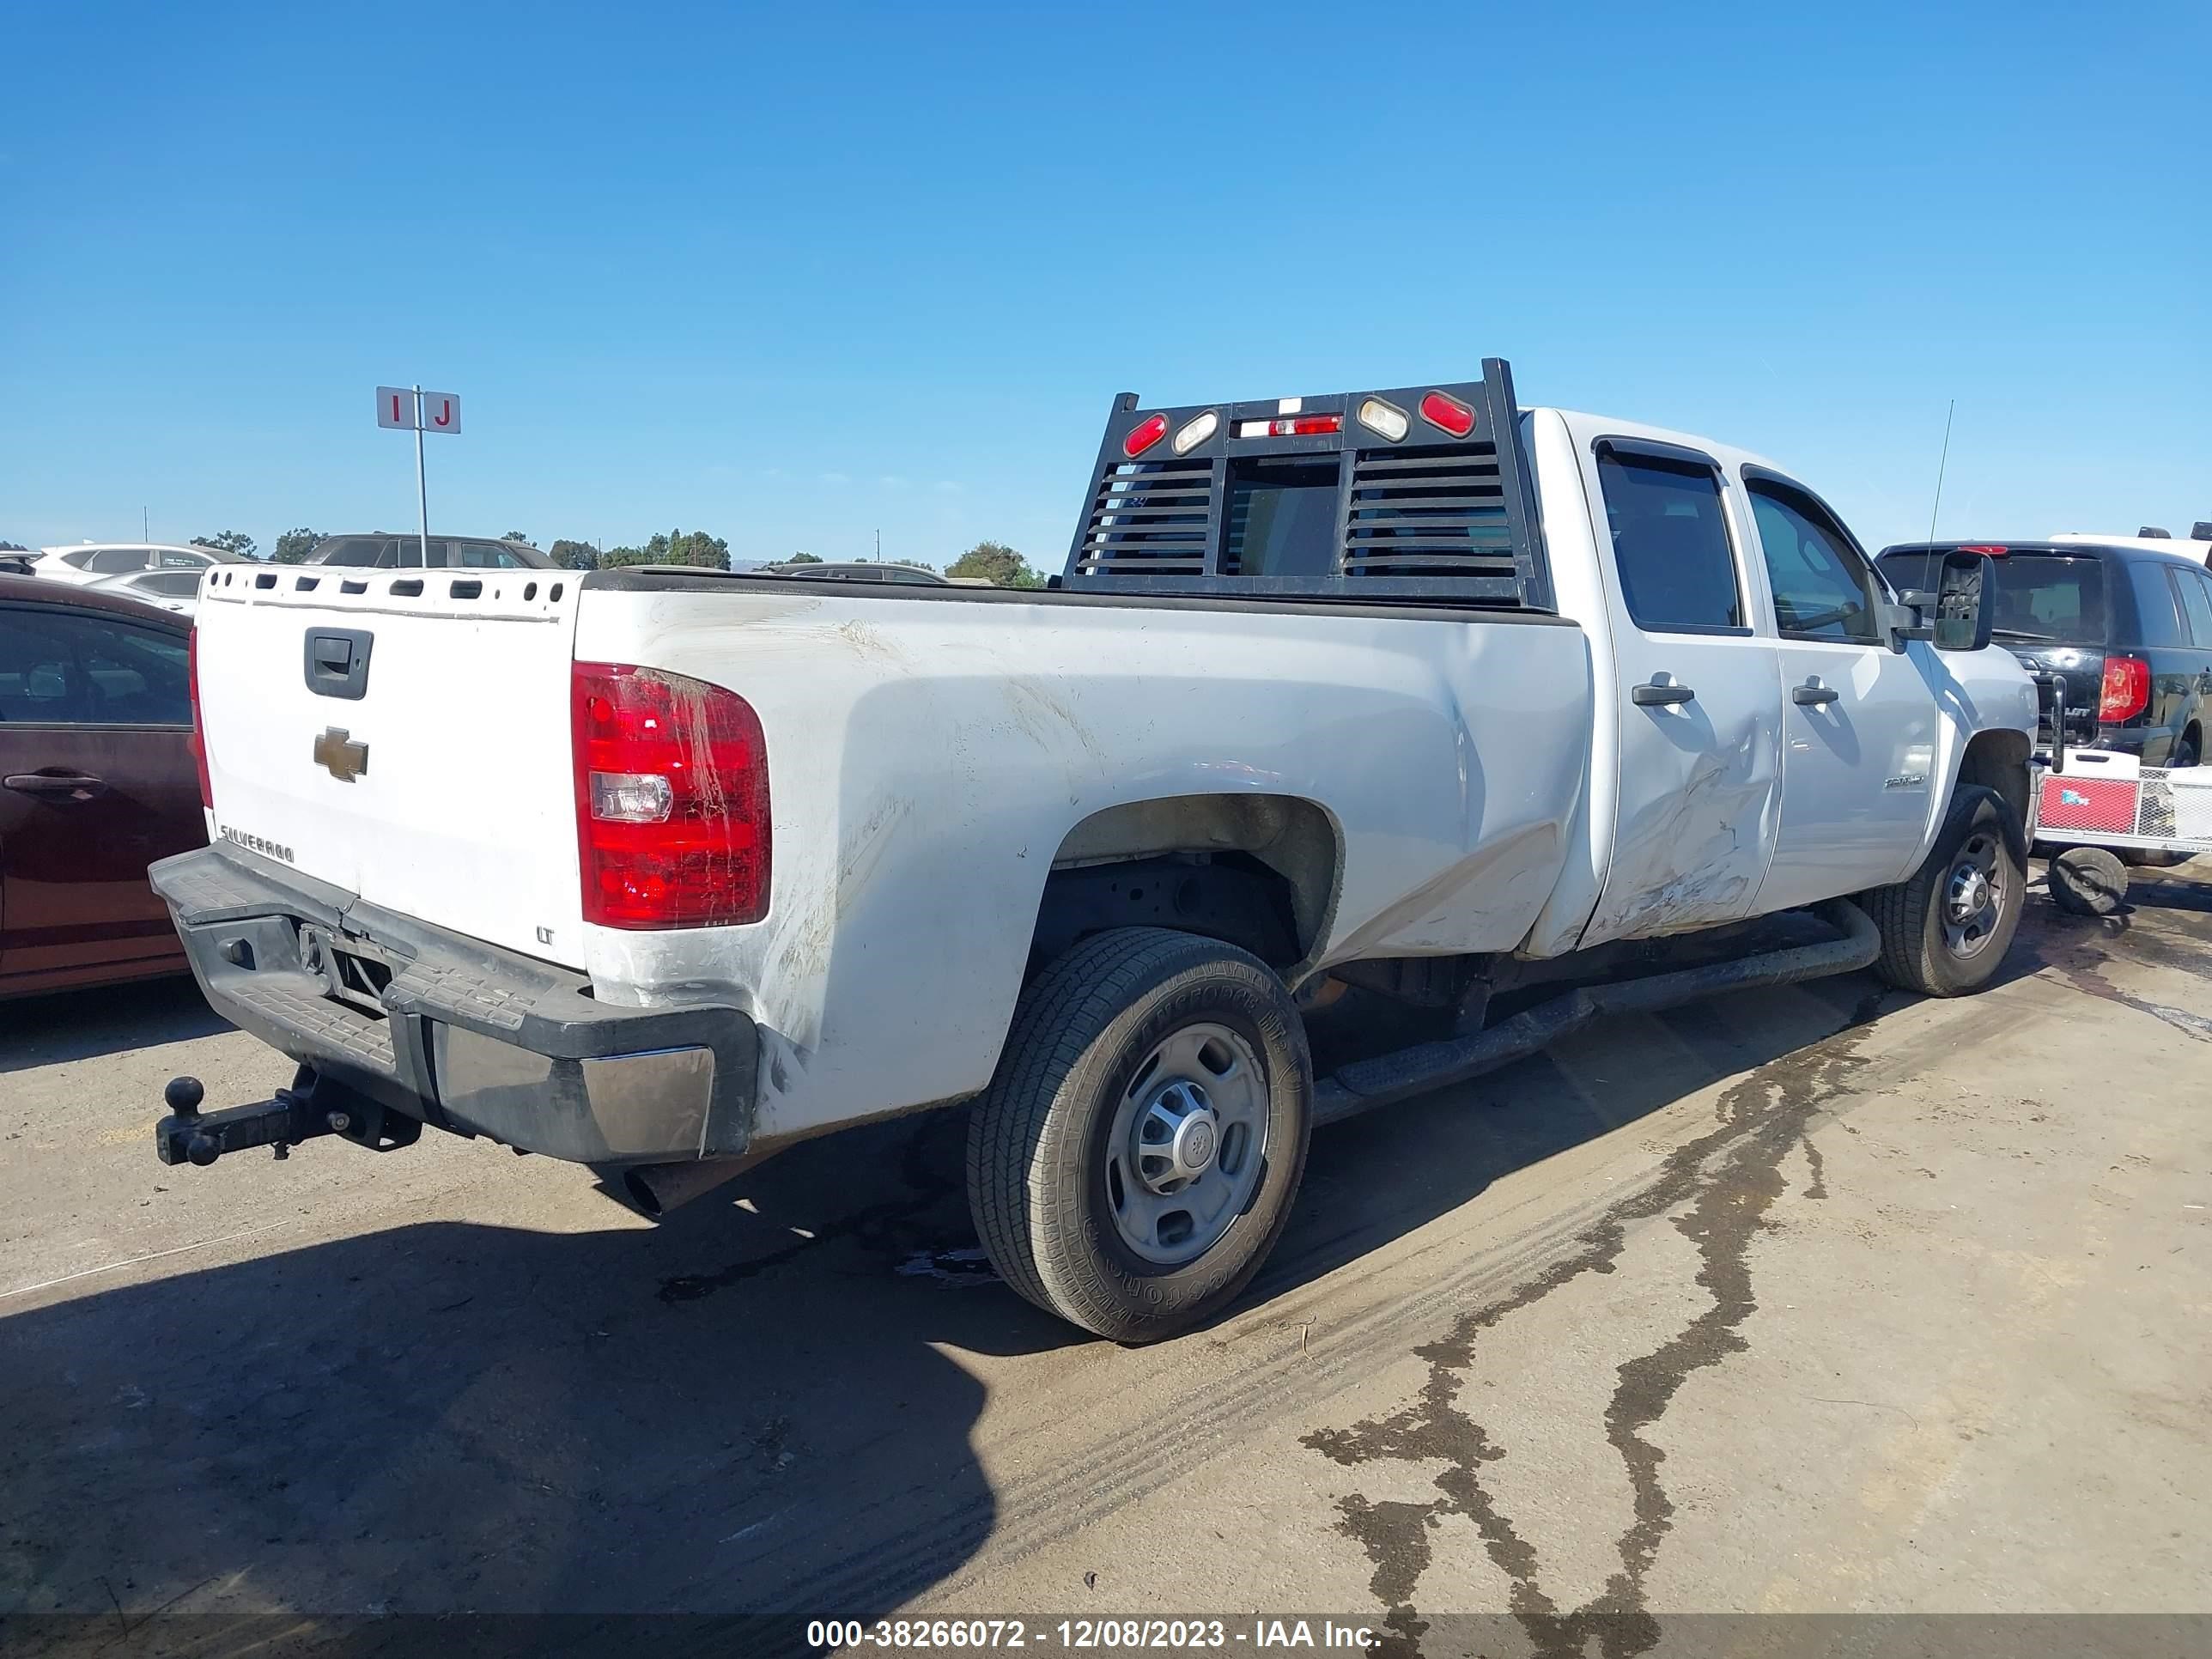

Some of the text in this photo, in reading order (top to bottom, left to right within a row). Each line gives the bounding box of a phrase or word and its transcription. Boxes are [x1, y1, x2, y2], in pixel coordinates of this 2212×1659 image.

[392, 395, 399, 422] I
[434, 399, 450, 426] J
[221, 824, 295, 864] SILVERADO
[537, 925, 555, 946] LT
